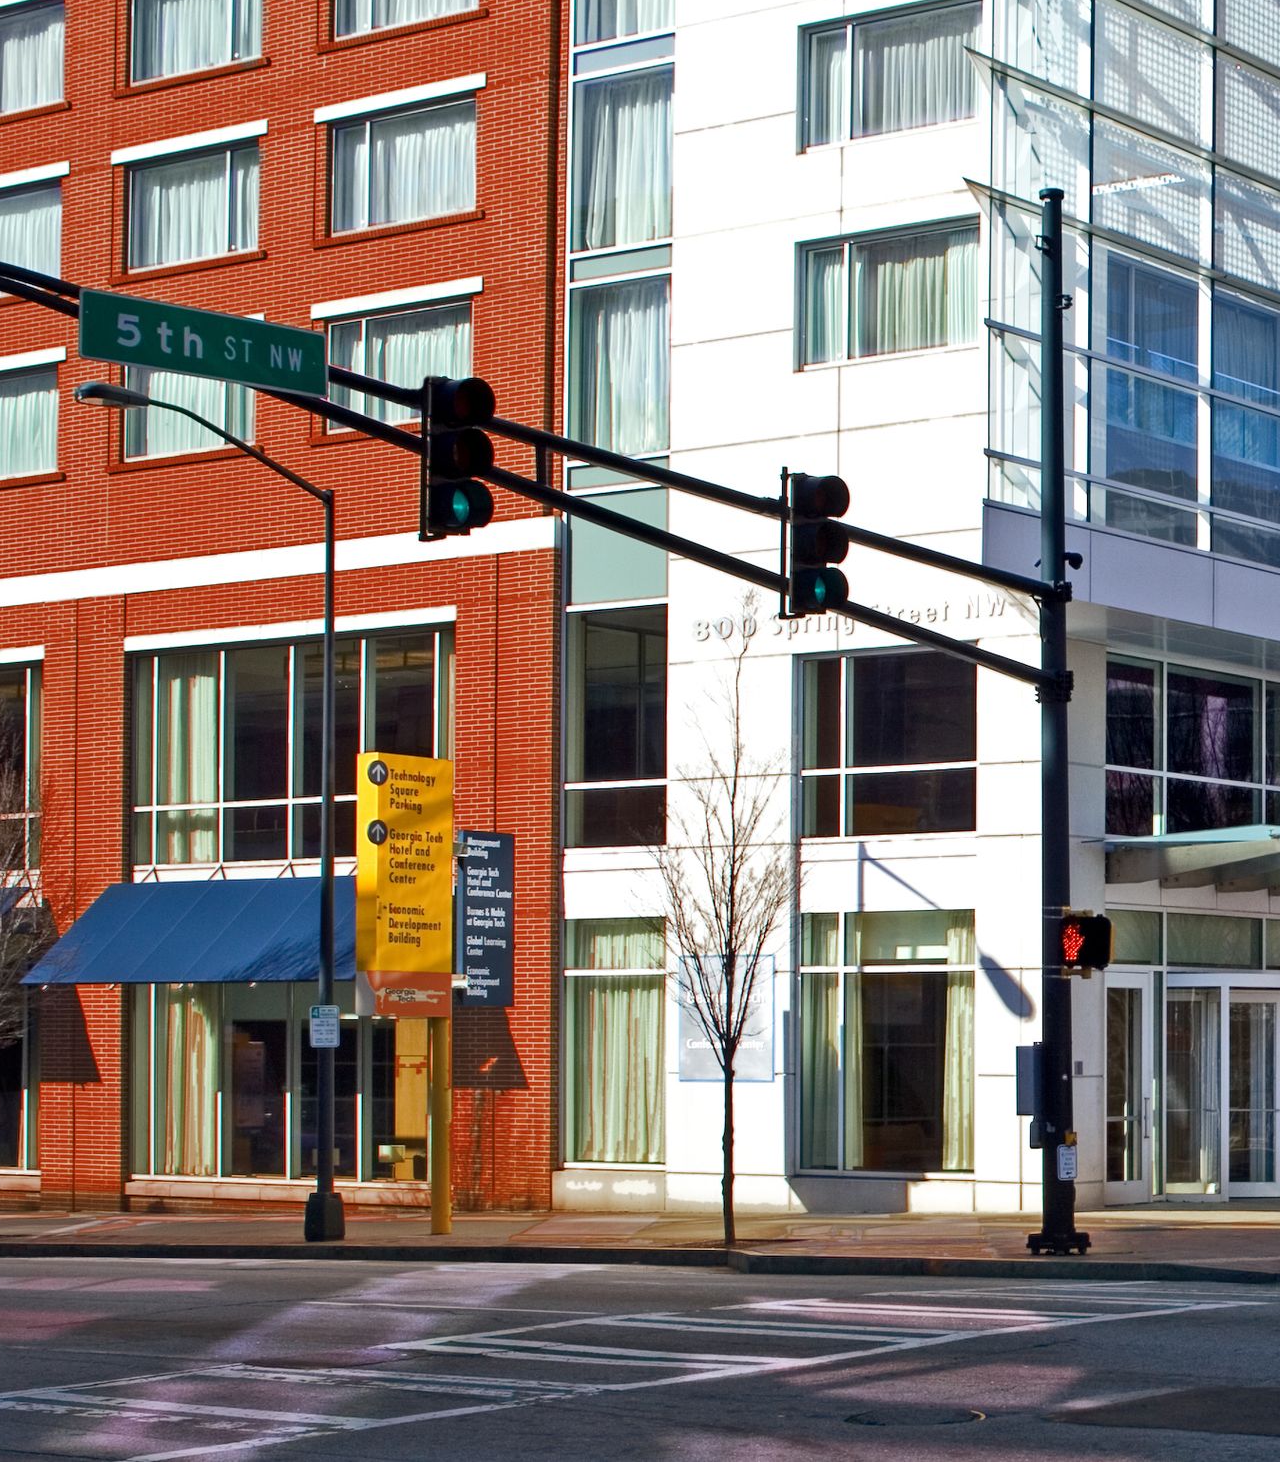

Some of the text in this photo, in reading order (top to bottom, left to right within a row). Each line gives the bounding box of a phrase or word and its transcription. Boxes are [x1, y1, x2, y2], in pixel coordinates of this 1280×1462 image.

[117, 313, 302, 372] 5th ST NW
[769, 611, 855, 640] Spring
[965, 597, 1006, 619] NW
[390, 769, 436, 787] Technology
[390, 784, 419, 797] Square
[390, 798, 422, 814] Parking
[389, 829, 443, 845] Georgia Tech
[390, 843, 430, 857] Hotel and
[389, 858, 436, 871] Conference
[389, 872, 417, 884] Center
[467, 866, 499, 879] Georgia Tech
[467, 876, 492, 887] Hotel and
[467, 887, 512, 899] Conference Center
[389, 903, 425, 916] Economic
[466, 906, 506, 917] Barnes & Noble
[389, 918, 441, 932] Development
[473, 917, 493, 929] Georgia
[494, 918, 505, 928] Tech
[389, 932, 421, 947] Building
[466, 936, 506, 949] Global Learning
[467, 946, 483, 956] Center
[385, 988, 416, 996] Georgia
